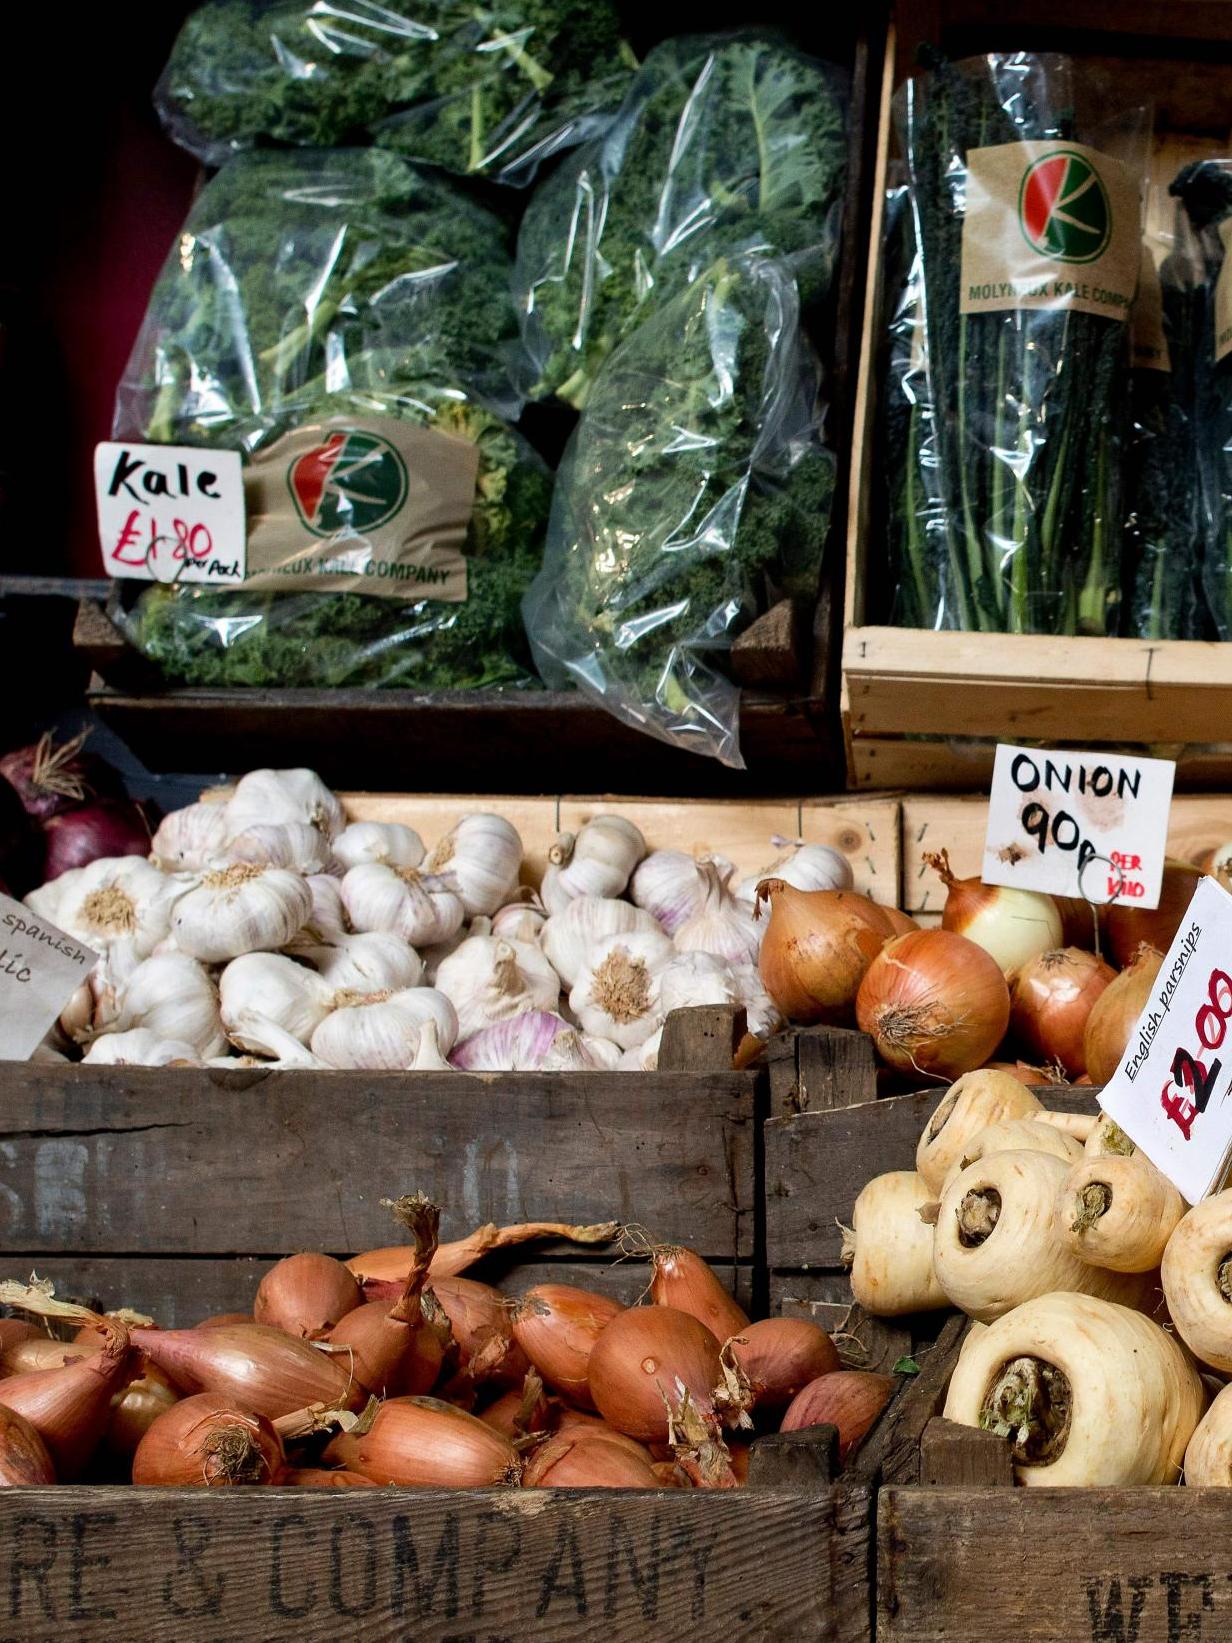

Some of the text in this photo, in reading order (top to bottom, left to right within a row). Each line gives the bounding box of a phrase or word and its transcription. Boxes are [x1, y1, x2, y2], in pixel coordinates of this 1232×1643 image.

[108, 450, 222, 505] Kale
[364, 560, 450, 584] COMPANY
[1011, 753, 1141, 799] ONION
[1021, 802, 1096, 871] 90p
[1110, 851, 1142, 871] PER
[1125, 1012, 1162, 1083] English
